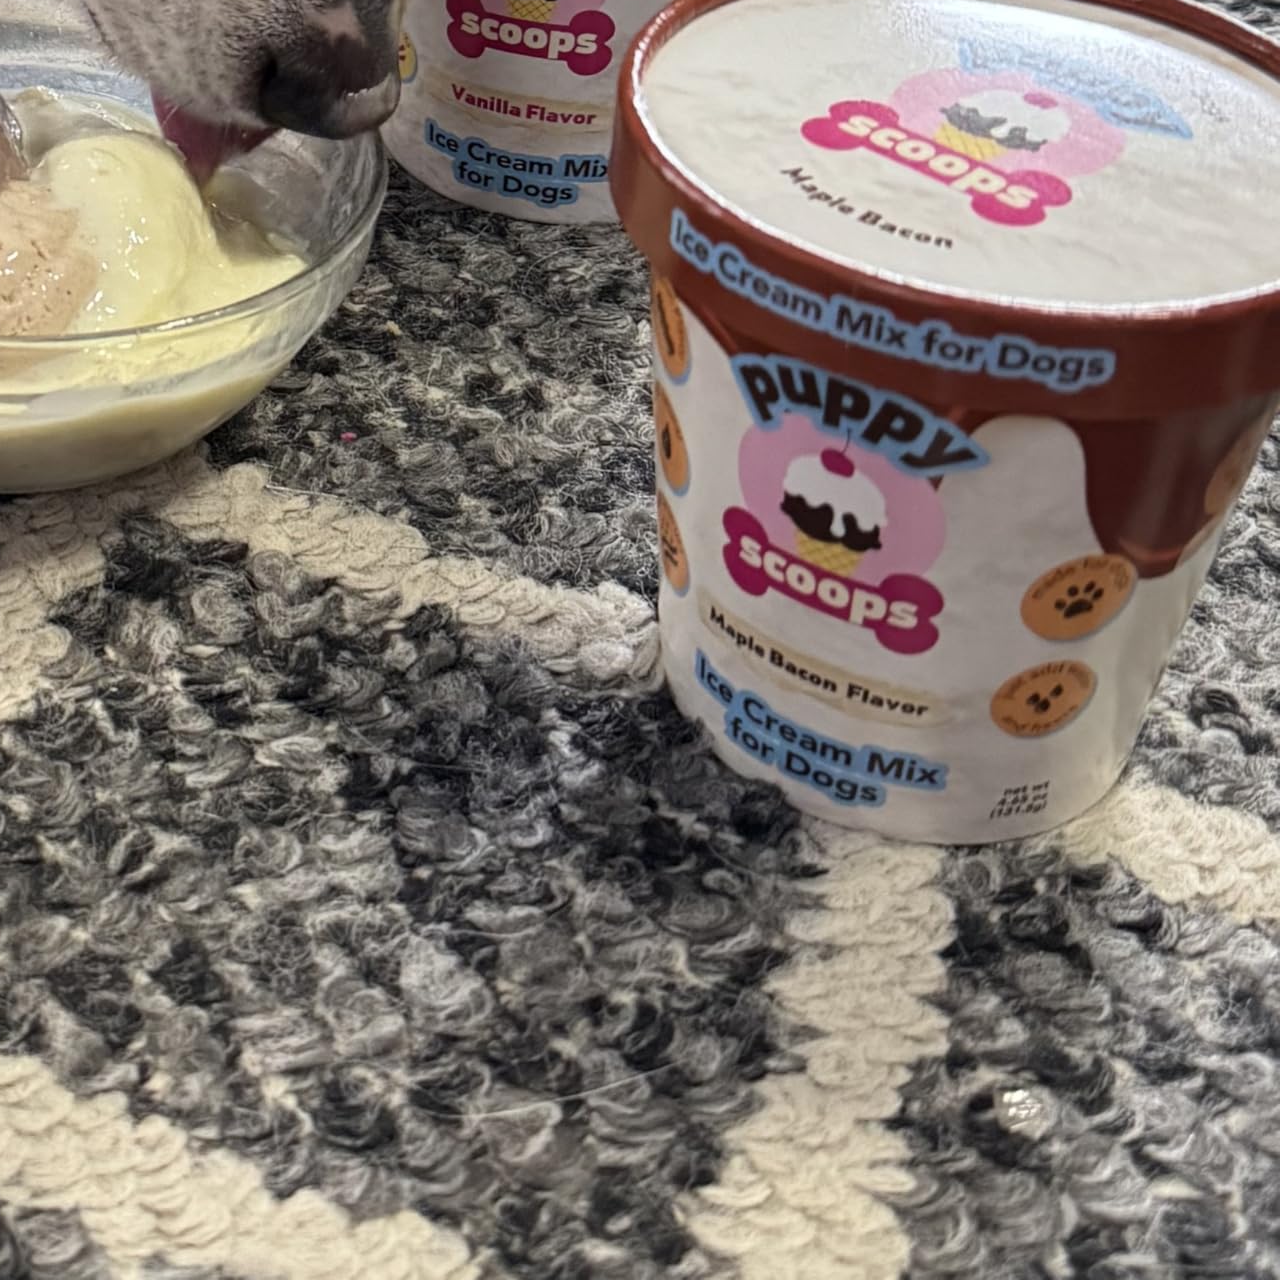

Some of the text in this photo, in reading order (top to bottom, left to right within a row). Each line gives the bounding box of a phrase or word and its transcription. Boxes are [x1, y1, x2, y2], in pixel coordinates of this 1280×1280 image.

[460, 12, 598, 59] scoops
[428, 123, 459, 153] Ice
[467, 142, 553, 176] Cream
[451, 84, 597, 126] Vanilla Flavor
[458, 162, 573, 204] for Dogs
[780, 163, 954, 249] Maple Bacon
[838, 113, 1040, 208] scoops
[674, 217, 1106, 383] Ice Cream Mix for Dogs
[739, 362, 979, 472] puppy
[738, 535, 919, 630] scoops
[708, 605, 930, 718] Maple Bacon Flavor
[698, 656, 940, 787] Ice Cream Mix
[730, 717, 878, 805] for Dogs
